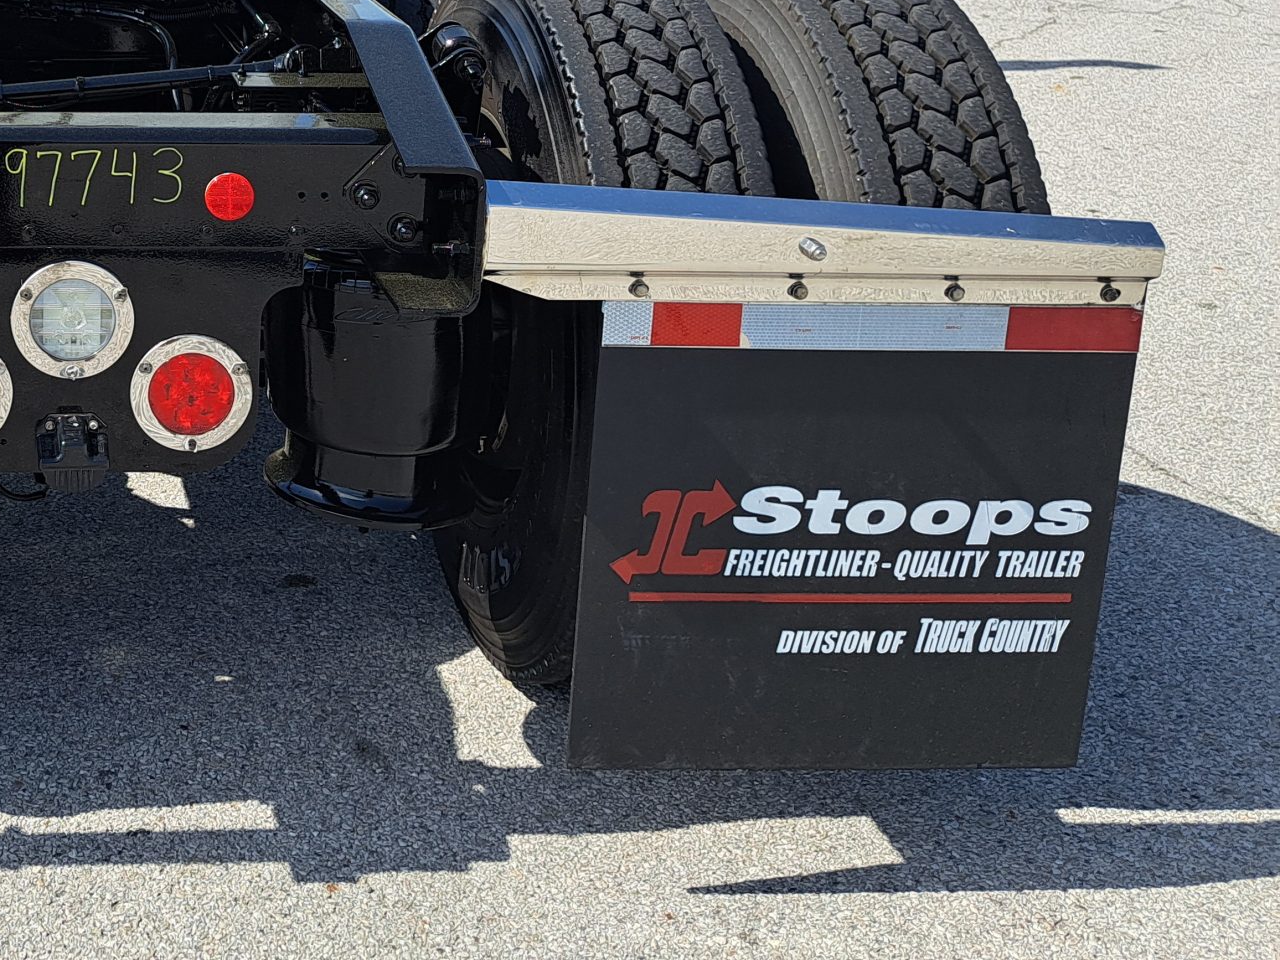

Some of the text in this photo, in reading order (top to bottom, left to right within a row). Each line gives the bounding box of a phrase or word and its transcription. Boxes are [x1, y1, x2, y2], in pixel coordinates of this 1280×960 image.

[733, 485, 1092, 546] Stoops
[995, 550, 1085, 578] TRAILER
[776, 617, 1071, 654] DIVISION OF TRUCK COUNTRY
